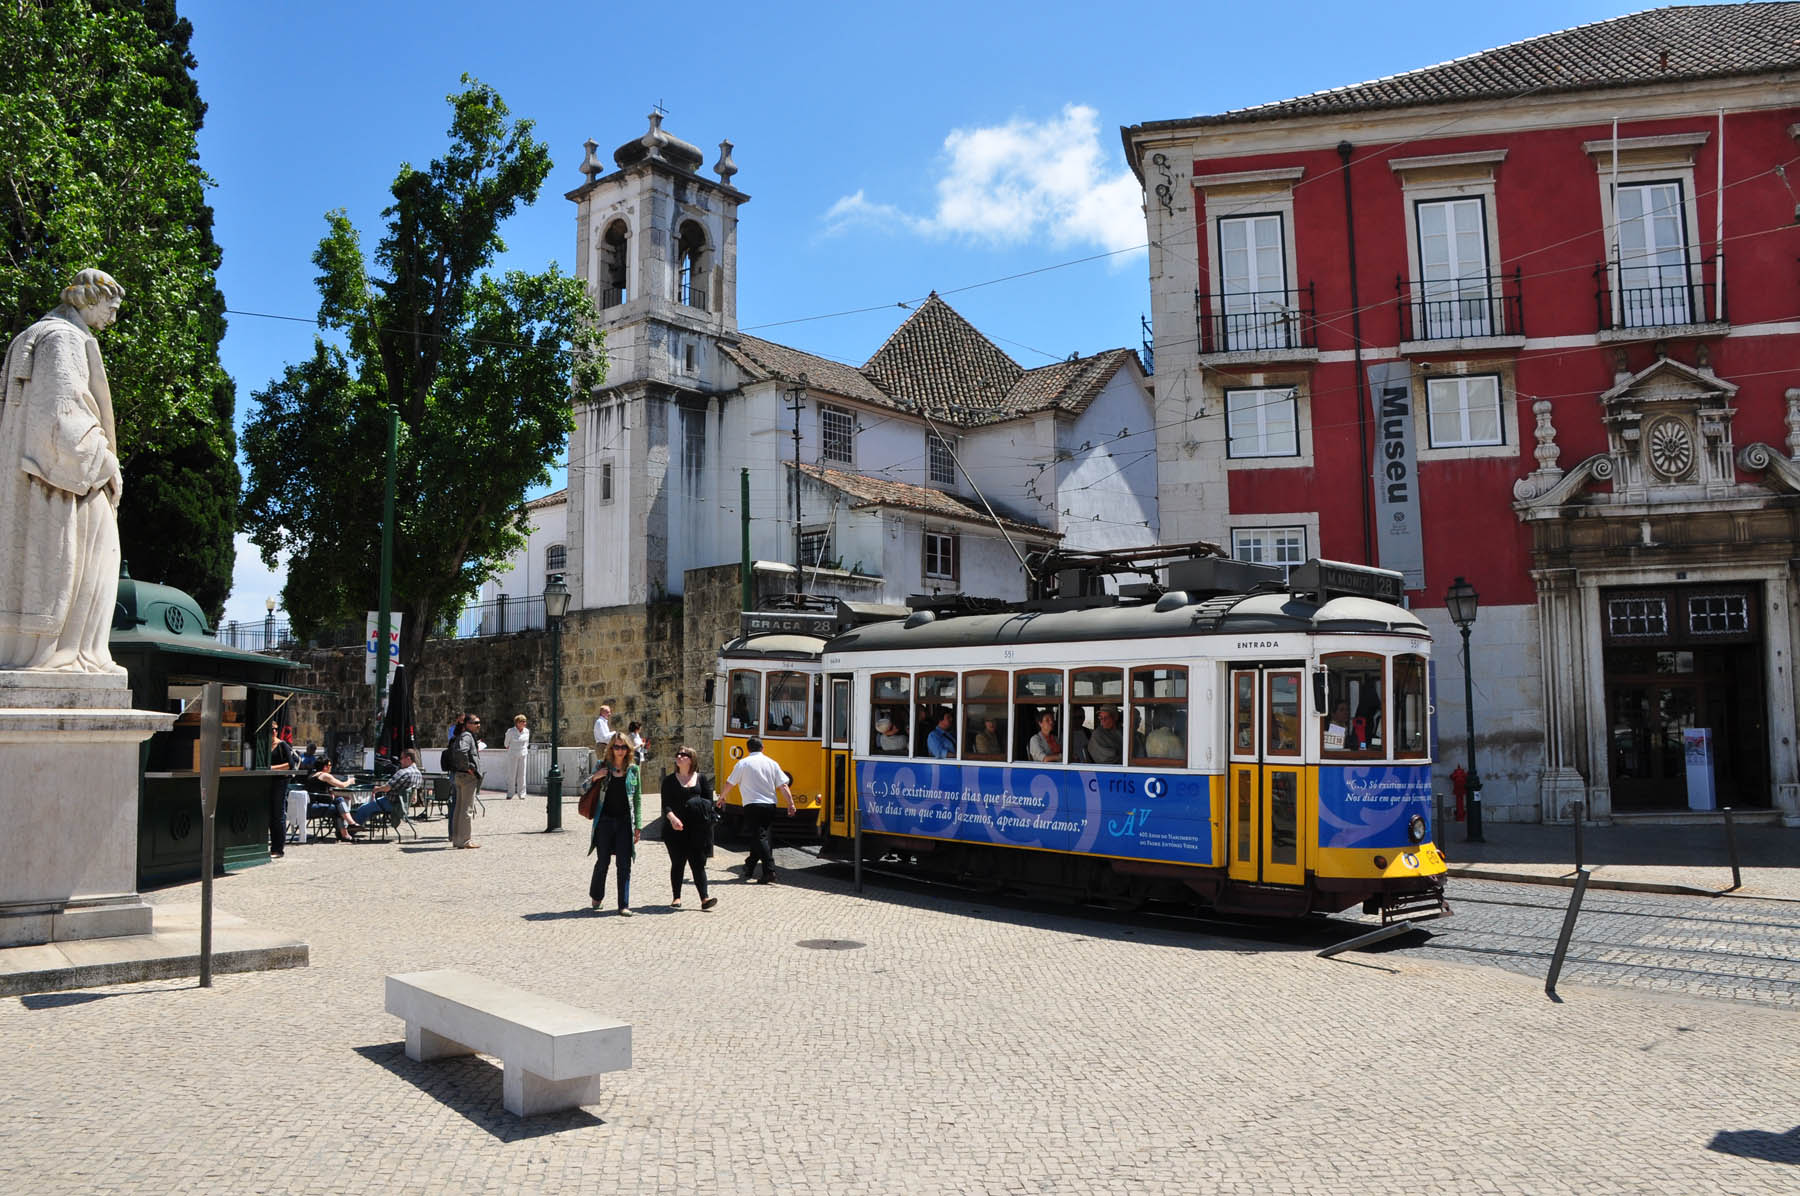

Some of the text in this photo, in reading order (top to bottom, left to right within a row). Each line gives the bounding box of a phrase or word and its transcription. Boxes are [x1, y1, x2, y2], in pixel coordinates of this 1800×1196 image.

[1383, 386, 1409, 503] Museu
[1338, 573, 1369, 589] MONIZ
[1378, 577, 1393, 594] 28
[813, 620, 831, 632] 28
[1237, 641, 1279, 649] ENTRADA
[902, 784, 943, 799] existimos
[944, 790, 960, 801] nos
[961, 787, 981, 802] dias
[983, 793, 1000, 809] que
[1001, 790, 1046, 808] fazemos.
[1344, 793, 1361, 802] Nos
[1362, 793, 1379, 802] dias
[867, 801, 884, 815] Nos
[885, 801, 903, 816] dias
[904, 807, 917, 817] em
[918, 809, 934, 823] que
[935, 807, 952, 820] não
[952, 807, 994, 828] fazemos,
[996, 814, 1031, 832] apenas
